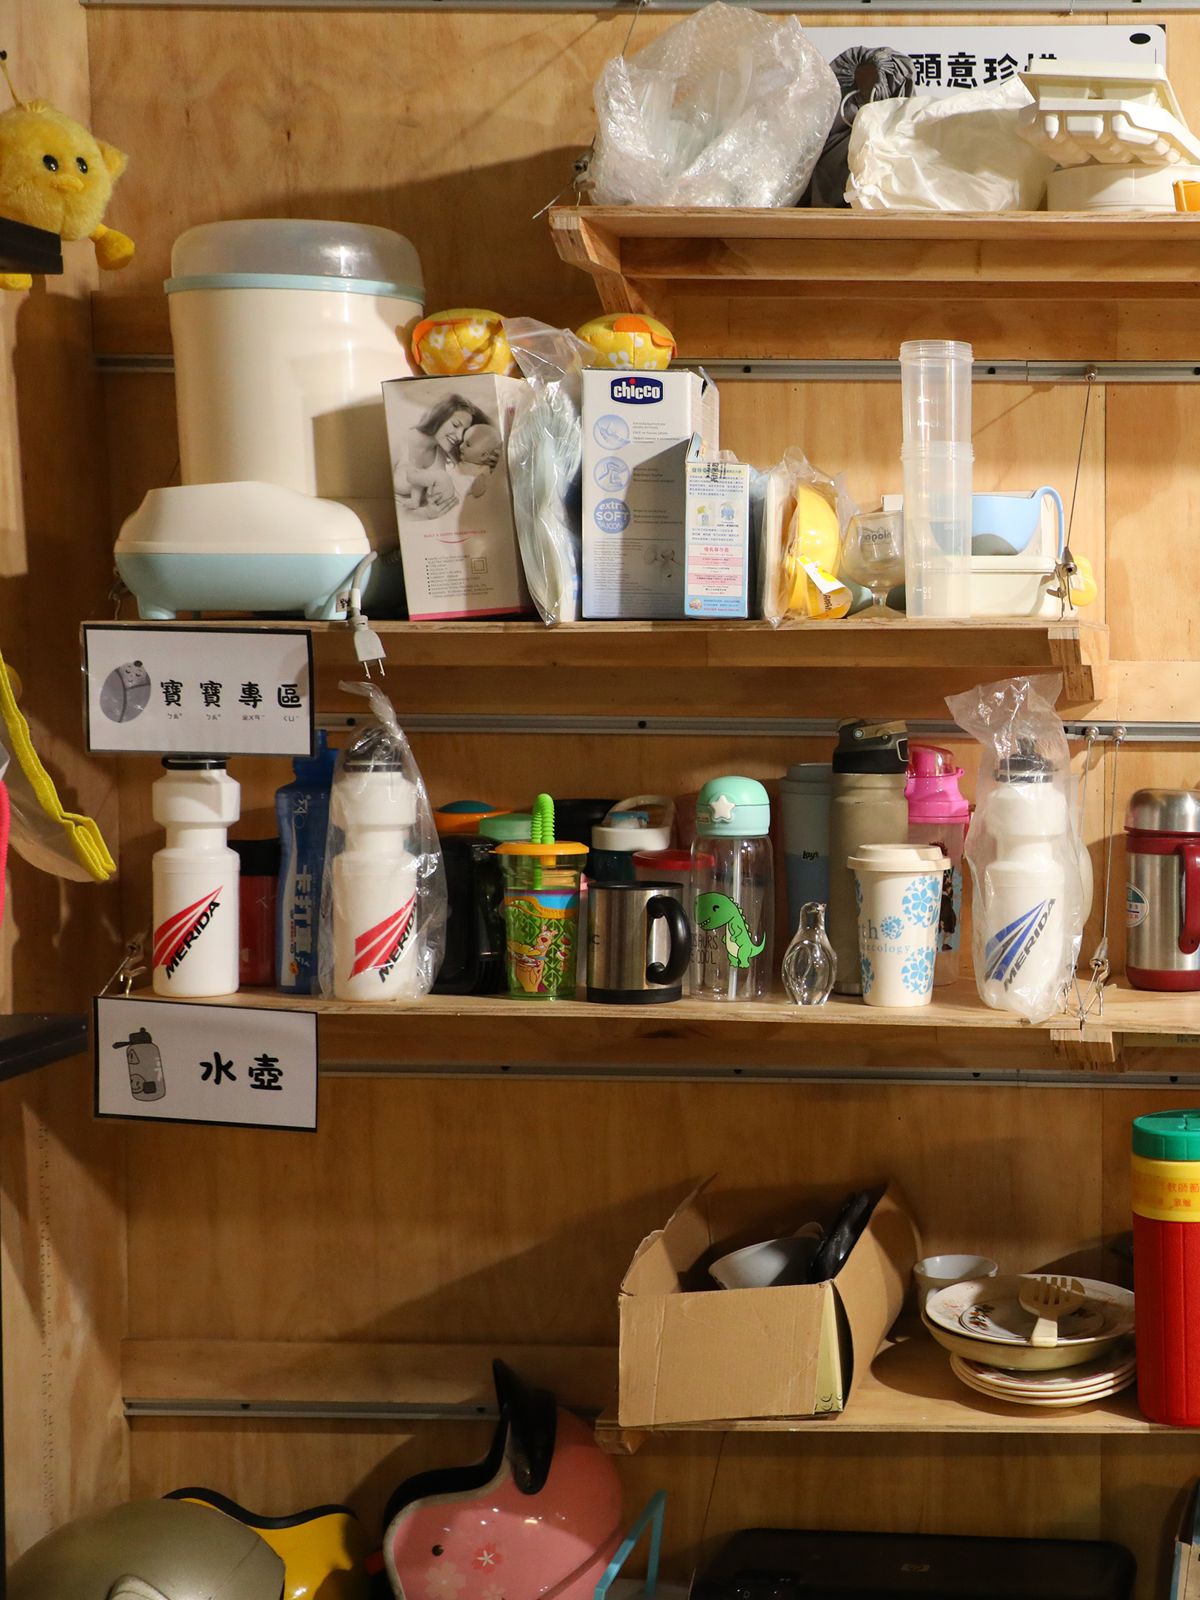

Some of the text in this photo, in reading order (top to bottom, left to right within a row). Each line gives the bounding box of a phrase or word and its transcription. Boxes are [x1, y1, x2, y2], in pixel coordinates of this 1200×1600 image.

[908, 52, 1057, 89] 願意珍
[613, 378, 661, 400] chicco
[160, 679, 302, 709] 寶寶專區
[165, 900, 221, 980] MERIDA
[378, 901, 417, 983] MERID
[1003, 898, 1057, 992] MERIDA
[199, 1051, 284, 1091] 水壺
